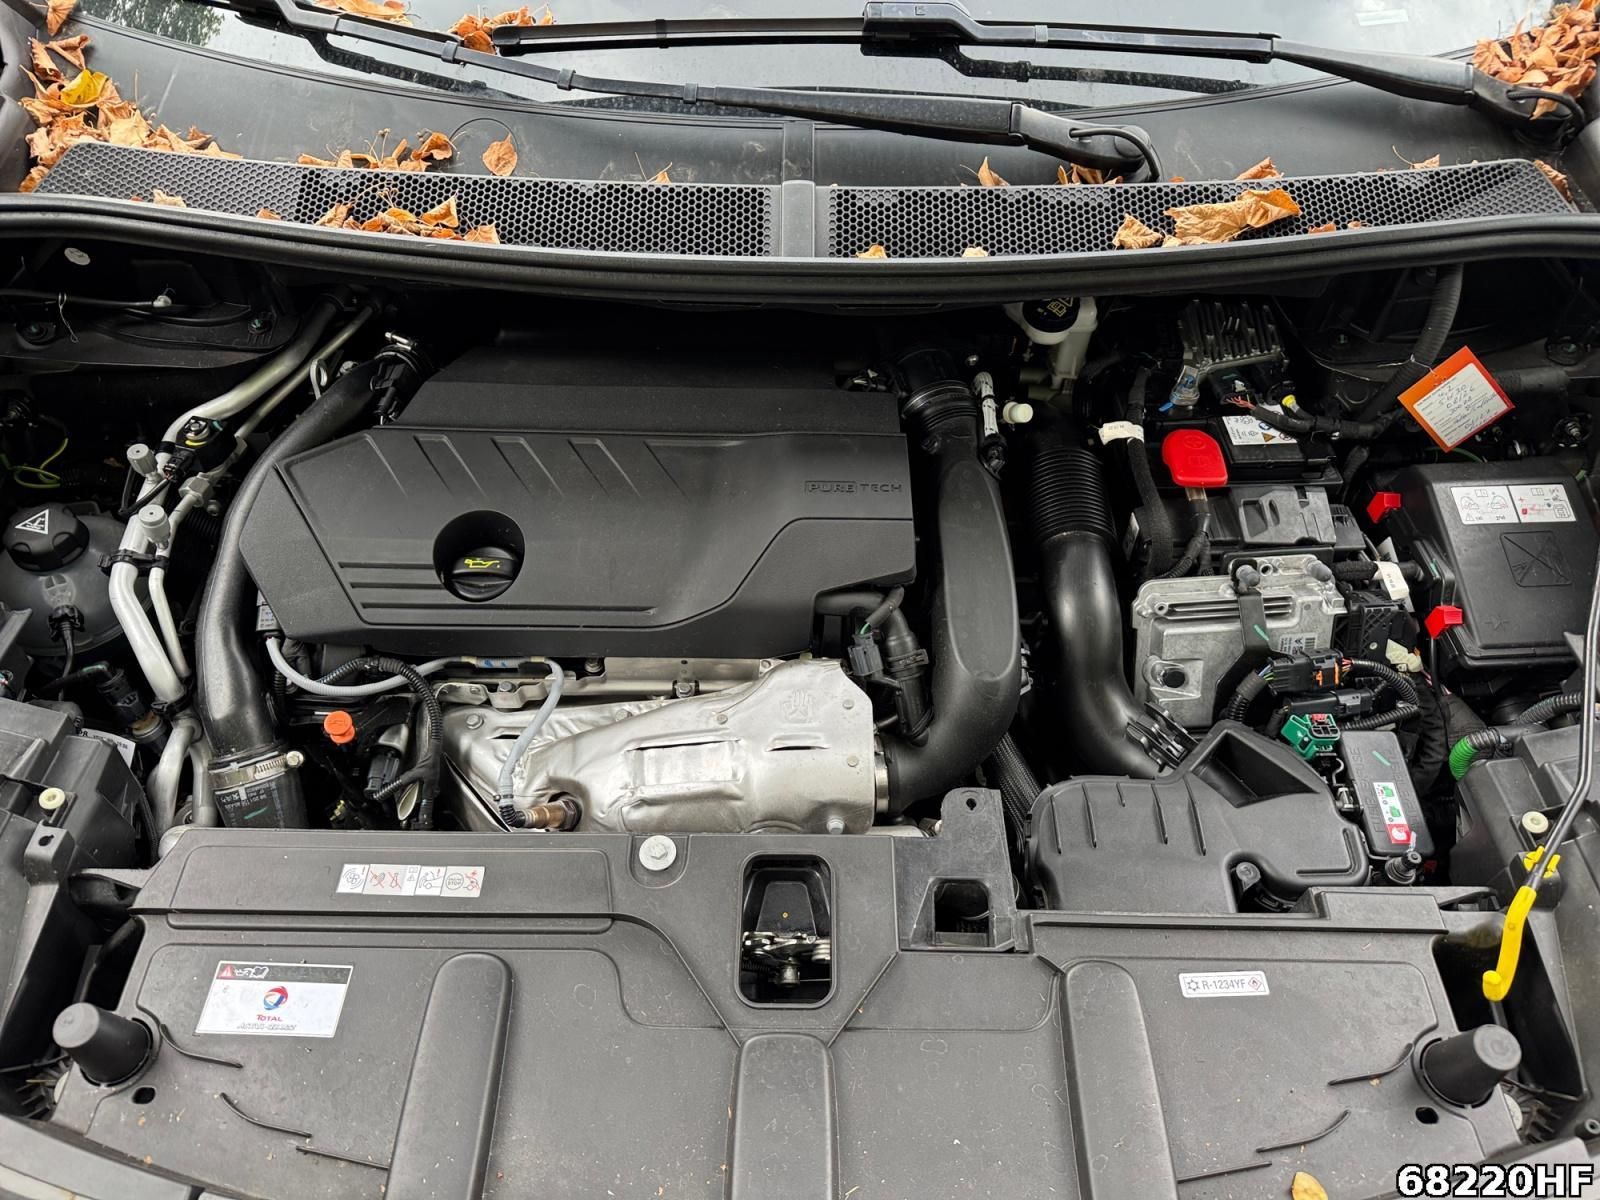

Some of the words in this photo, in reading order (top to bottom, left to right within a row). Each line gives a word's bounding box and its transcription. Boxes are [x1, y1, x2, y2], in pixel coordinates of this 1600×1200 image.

[807, 483, 856, 494] PURE
[859, 483, 903, 494] TECH
[1201, 979, 1246, 991] R-1234YF
[256, 1014, 284, 1022] TOTAL
